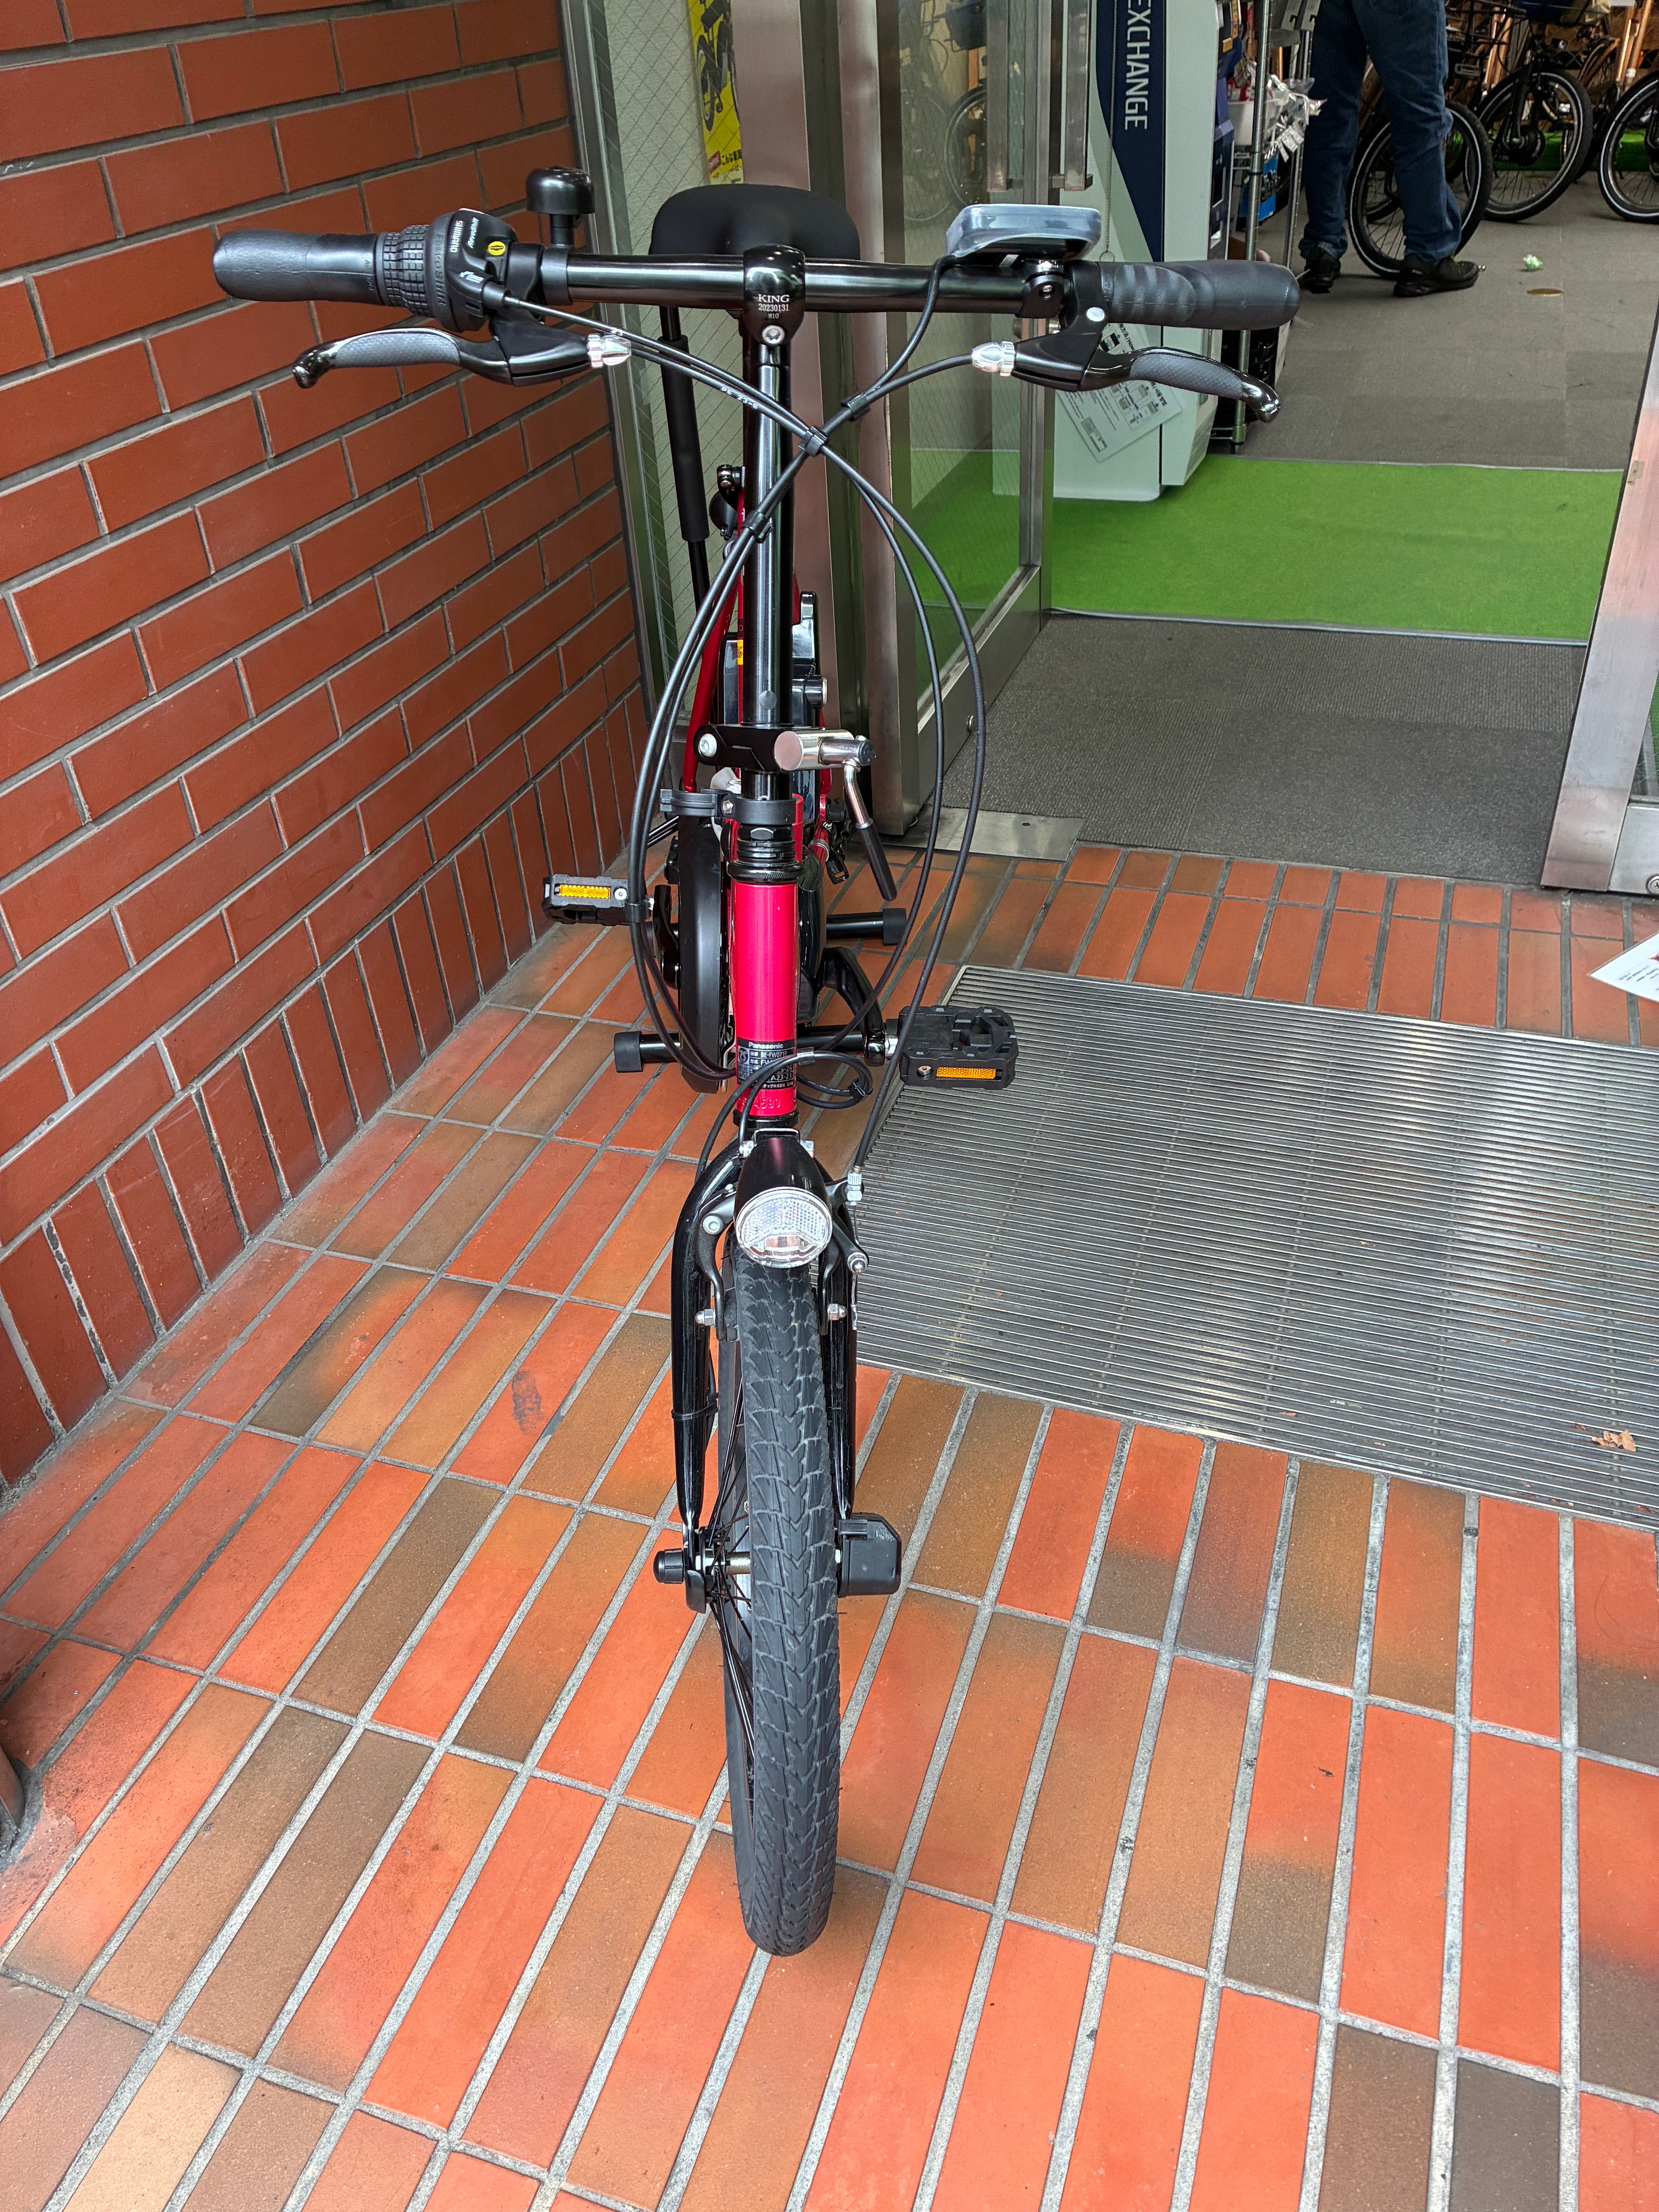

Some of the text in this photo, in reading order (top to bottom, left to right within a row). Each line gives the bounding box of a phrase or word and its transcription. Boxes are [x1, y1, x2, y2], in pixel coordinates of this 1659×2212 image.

[1125, 0, 1151, 130] EXCHANGE
[758, 294, 790, 303] KING
[758, 303, 789, 312] 20230131
[721, 386, 733, 395] PE
[748, 1041, 783, 1049] Panasonic
